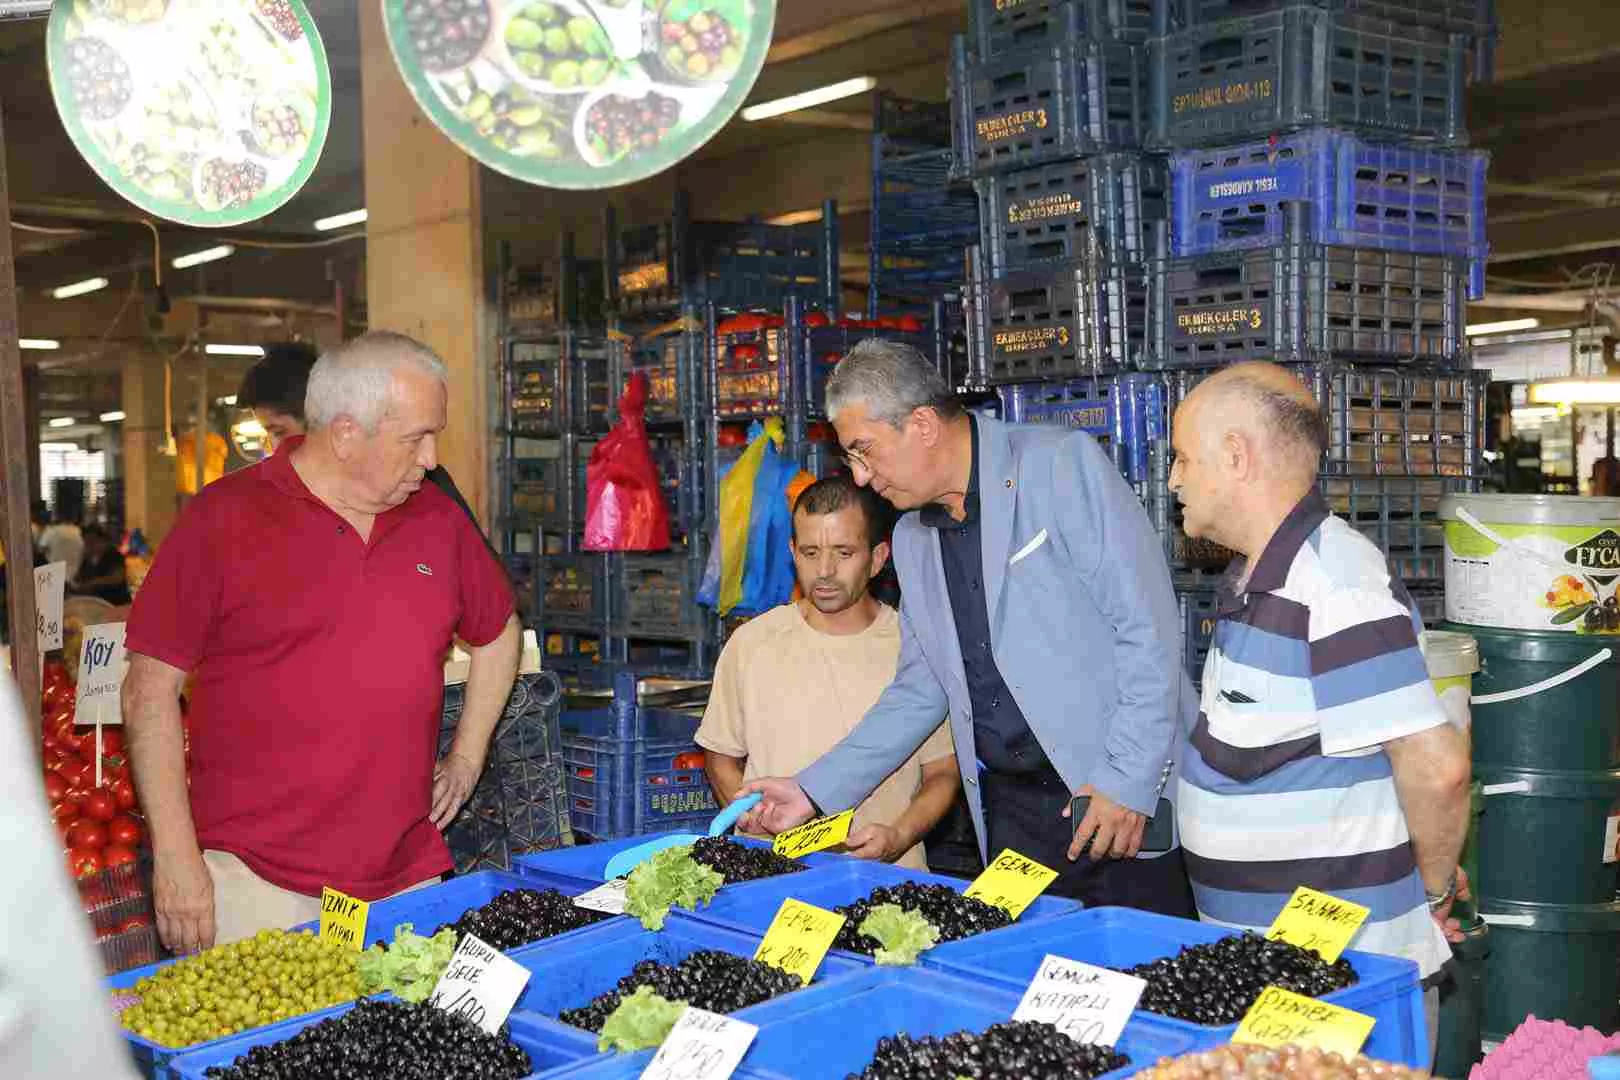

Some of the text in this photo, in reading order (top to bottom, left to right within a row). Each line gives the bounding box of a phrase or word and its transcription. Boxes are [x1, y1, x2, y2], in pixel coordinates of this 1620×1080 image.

[1036, 108, 1048, 128] 3
[1250, 308, 1262, 329] 3
[1058, 326, 1070, 346] 3
[459, 936, 496, 963] KURU
[446, 959, 485, 984] SELE
